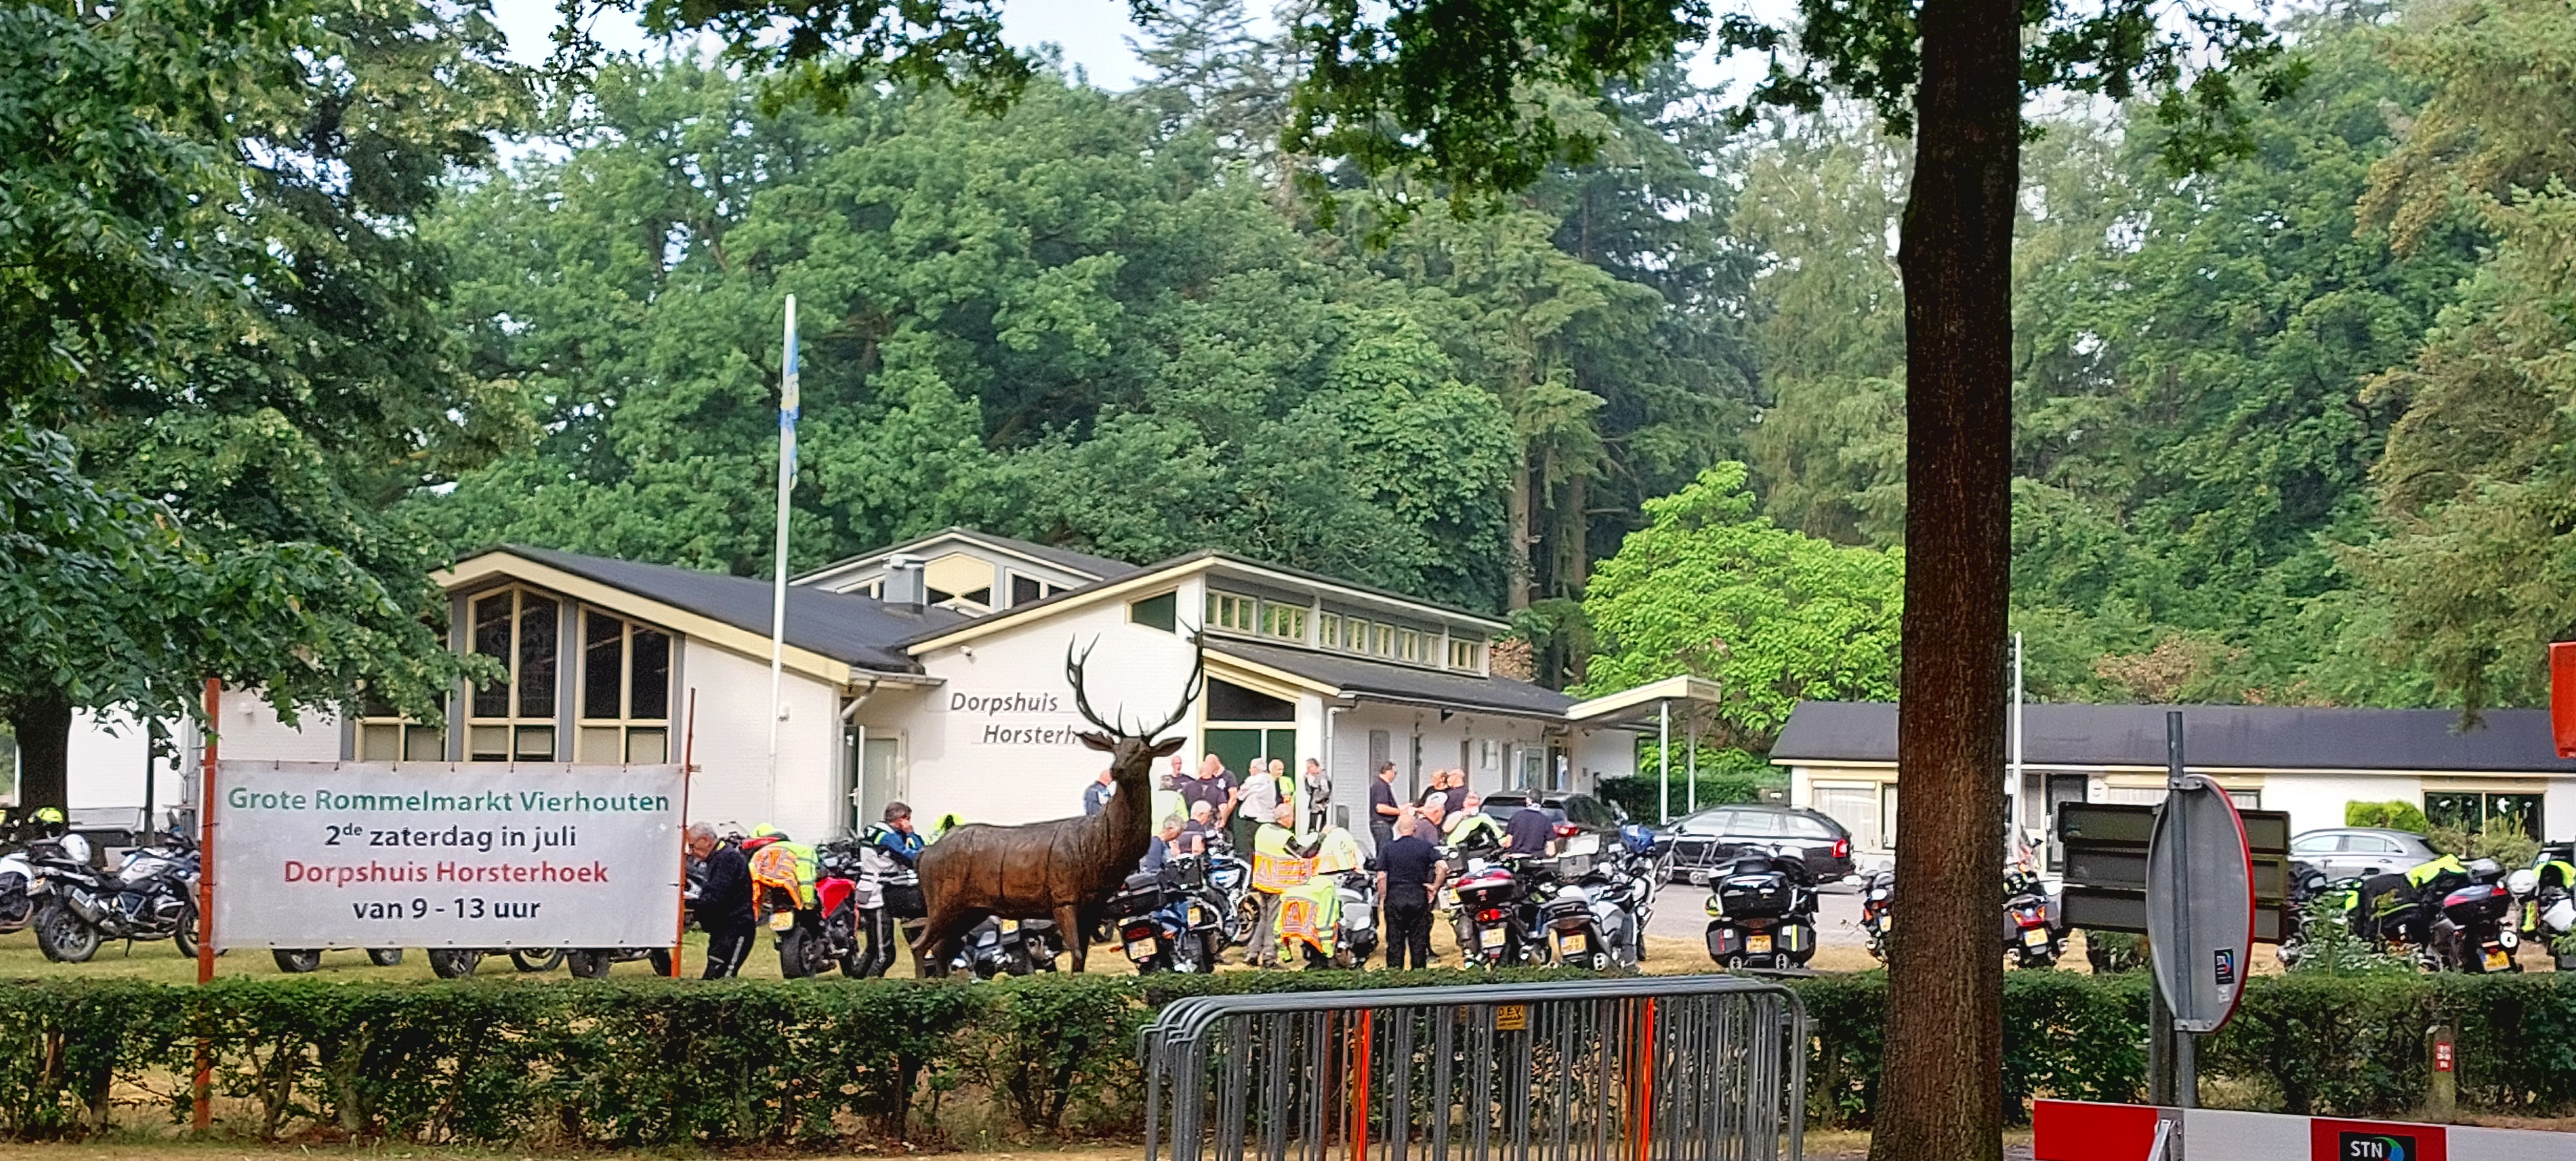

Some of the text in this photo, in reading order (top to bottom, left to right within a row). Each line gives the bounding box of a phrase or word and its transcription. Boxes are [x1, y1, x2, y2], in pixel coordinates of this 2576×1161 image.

[950, 692, 1058, 716] Dorpshuis
[983, 725, 1076, 744] Horsterh
[227, 787, 670, 812] Grote Rommelmarkt Vierhouten
[324, 822, 577, 852] 2de zaterdag in juli
[285, 860, 609, 888] Dorpshuis Horsterhoek
[353, 902, 403, 920] van
[411, 897, 428, 920] 9
[453, 897, 485, 919] 13
[494, 902, 541, 919] uur
[2350, 1140, 2383, 1158] STN
